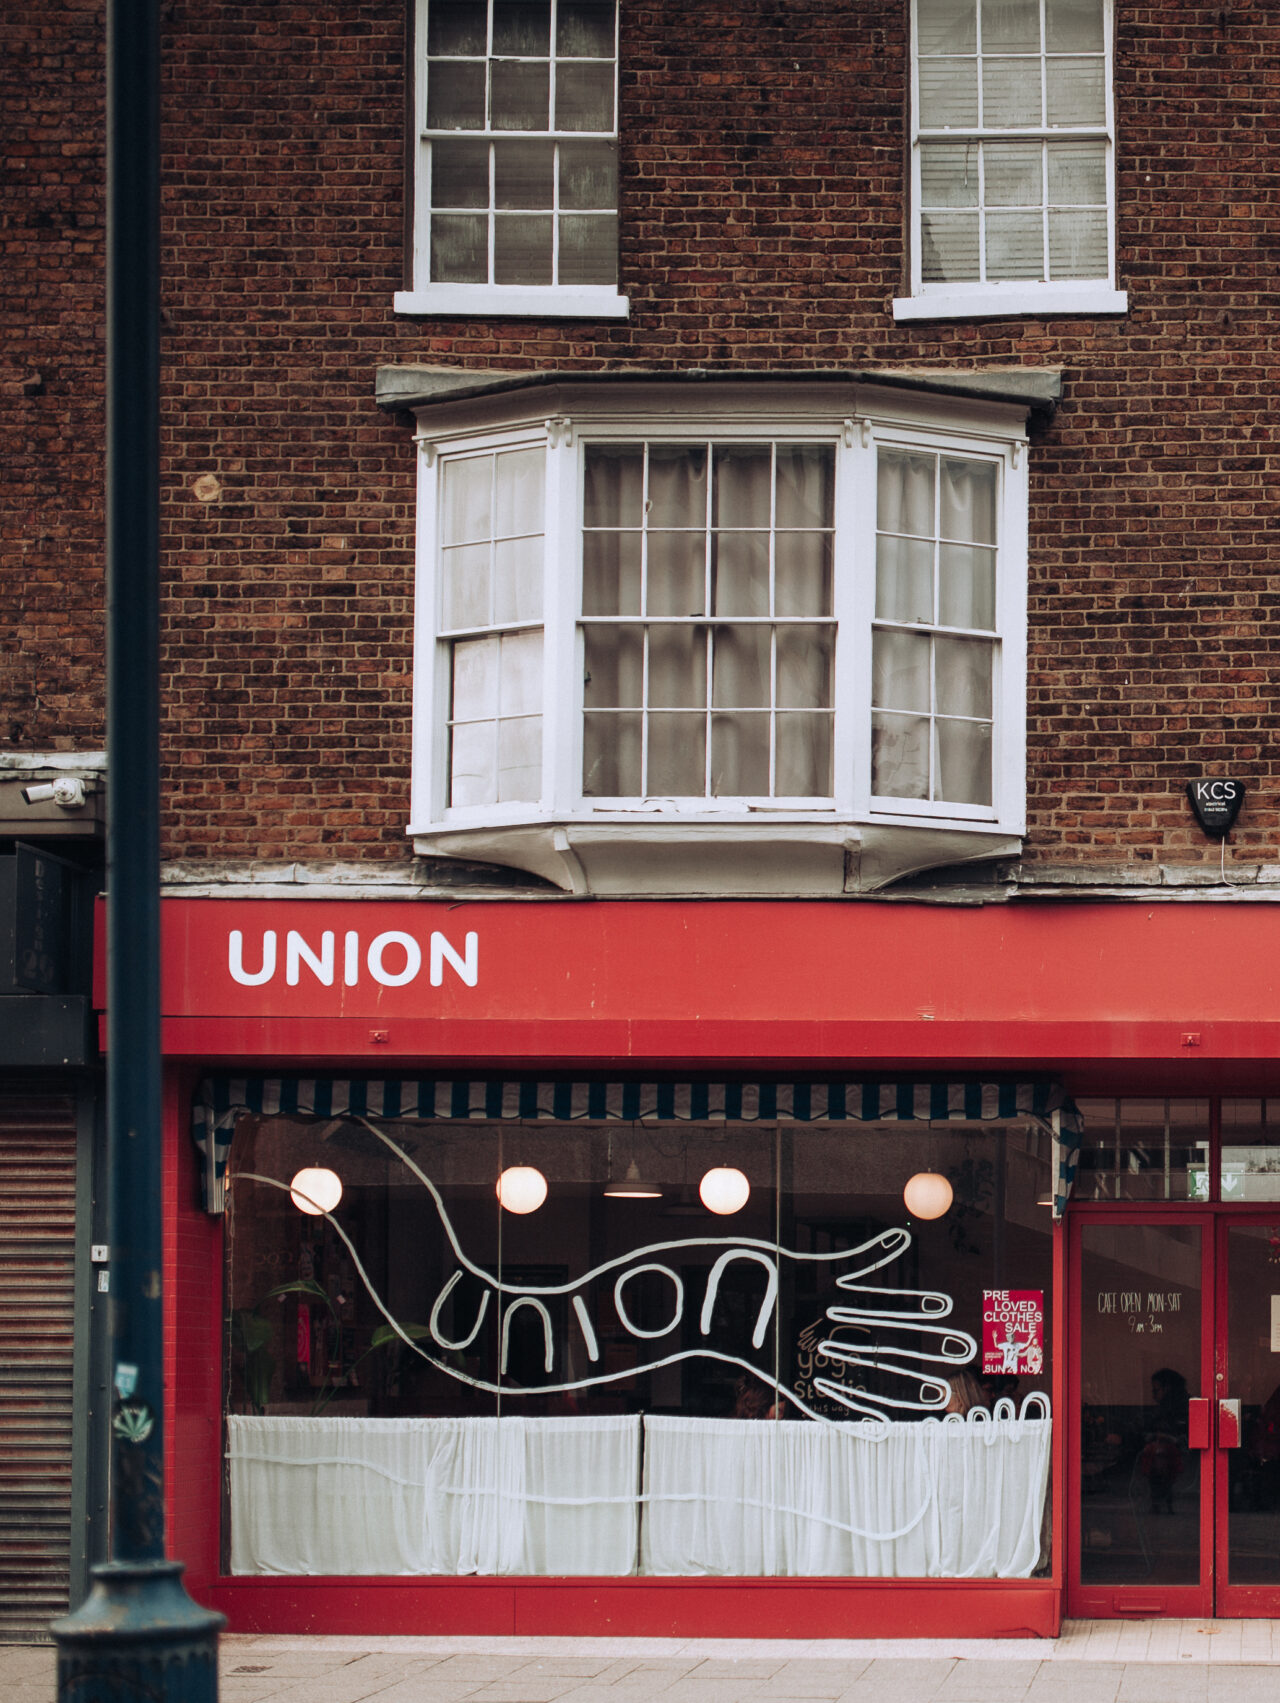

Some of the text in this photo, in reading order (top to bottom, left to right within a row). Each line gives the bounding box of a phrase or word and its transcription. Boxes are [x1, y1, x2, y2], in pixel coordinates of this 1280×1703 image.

[1197, 781, 1236, 800] KCS
[228, 930, 479, 987] UNION
[984, 1290, 1010, 1301] PRE
[994, 1301, 1037, 1312] LOVED
[1120, 1292, 1141, 1313] OPEN
[983, 1311, 1042, 1322] CLOTHES
[1005, 1322, 1037, 1333] SALE
